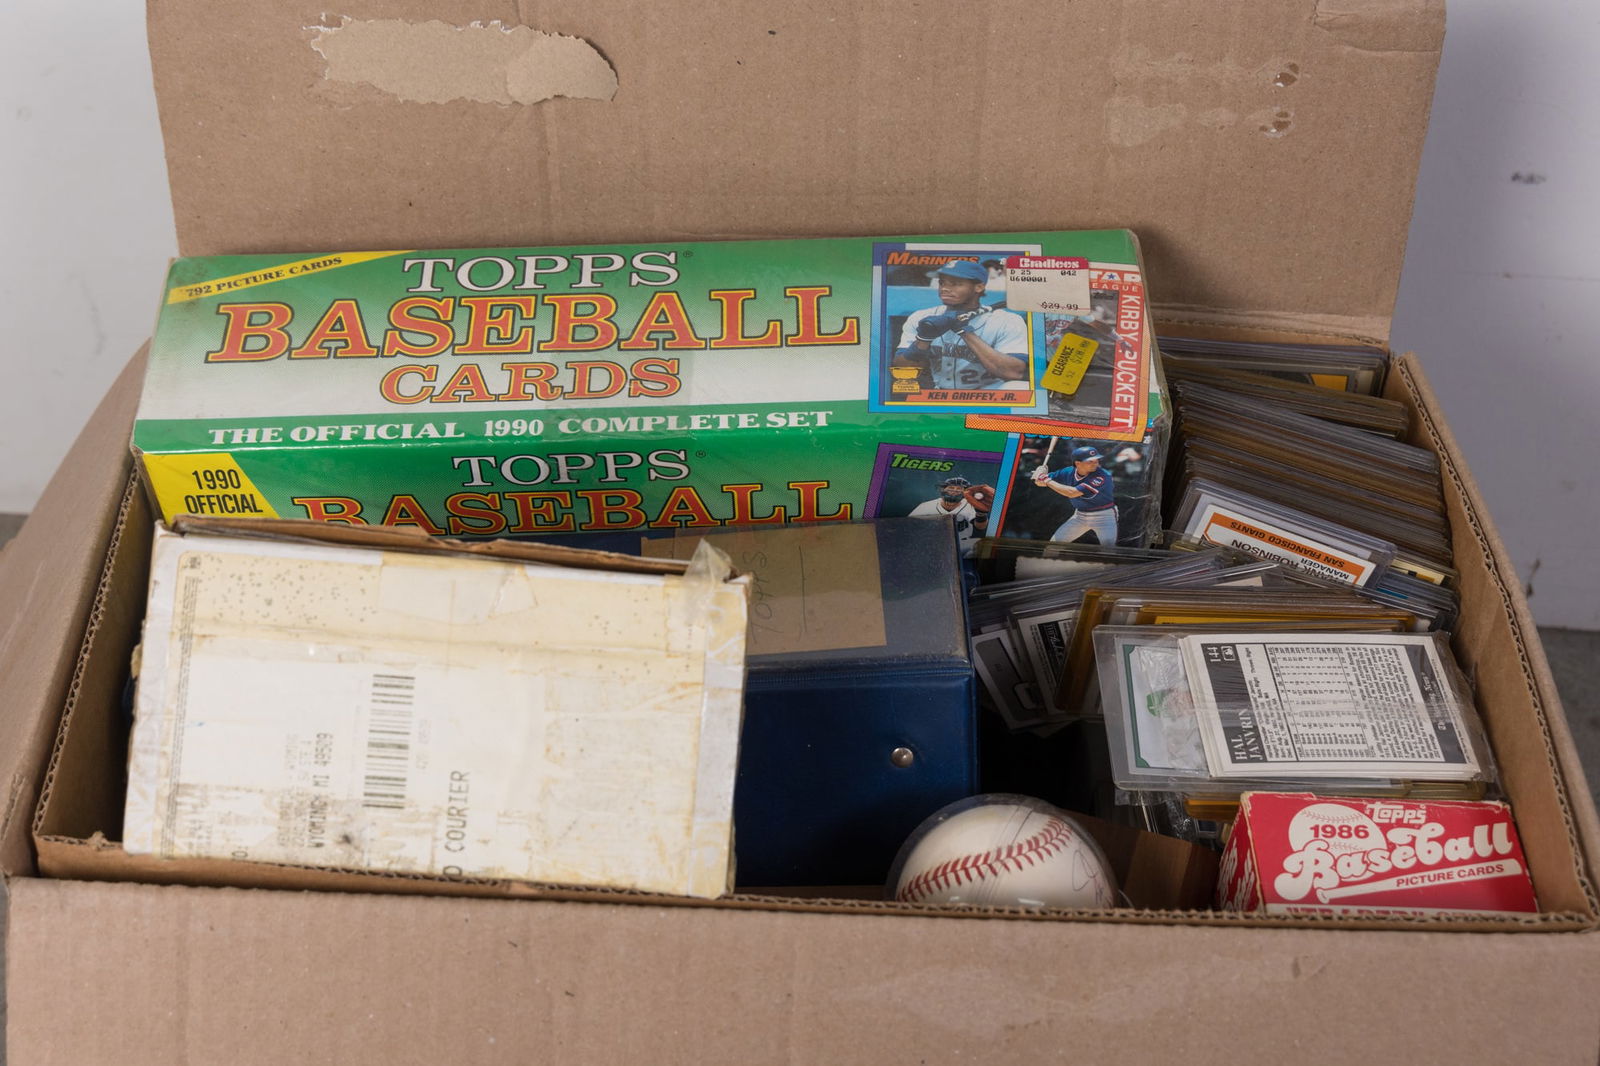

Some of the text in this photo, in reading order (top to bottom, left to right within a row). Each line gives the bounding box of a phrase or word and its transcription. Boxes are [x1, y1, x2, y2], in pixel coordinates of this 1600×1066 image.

[186, 256, 342, 297] 792 PICTURE CARDS
[403, 251, 680, 292] TOPPS
[1019, 257, 1079, 269] Bradlees
[1092, 283, 1138, 292] EAGUE
[1041, 302, 1079, 310] $29.99
[204, 286, 861, 363] BASEBALL
[1051, 345, 1075, 377] CLEARANCE
[1113, 294, 1141, 428] KIRBY PUCKETT
[379, 358, 682, 404] CARDS
[928, 392, 1017, 402] KEN GRIFFEY, JR.
[209, 411, 833, 445] THE OFFICIAL 1990 COMPLETE SET
[192, 469, 241, 490] 1990
[452, 450, 690, 486] TOPPS
[184, 494, 263, 514] OFFICIAL
[293, 481, 853, 535] BASEBALL
[1230, 521, 1345, 568] SAN FRANCISCO GIANTS
[1231, 539, 1300, 571] ROBINSON
[1300, 557, 1349, 580] MANAGER
[1207, 646, 1220, 662] 144
[1231, 734, 1247, 761] HAL
[1238, 707, 1263, 761] JANVRIN
[445, 770, 470, 852] COURIER
[1366, 802, 1426, 824] Topps
[1310, 824, 1369, 839] 1986
[1274, 822, 1513, 901] Baseball
[1396, 863, 1505, 887] PICTURE CARDS
